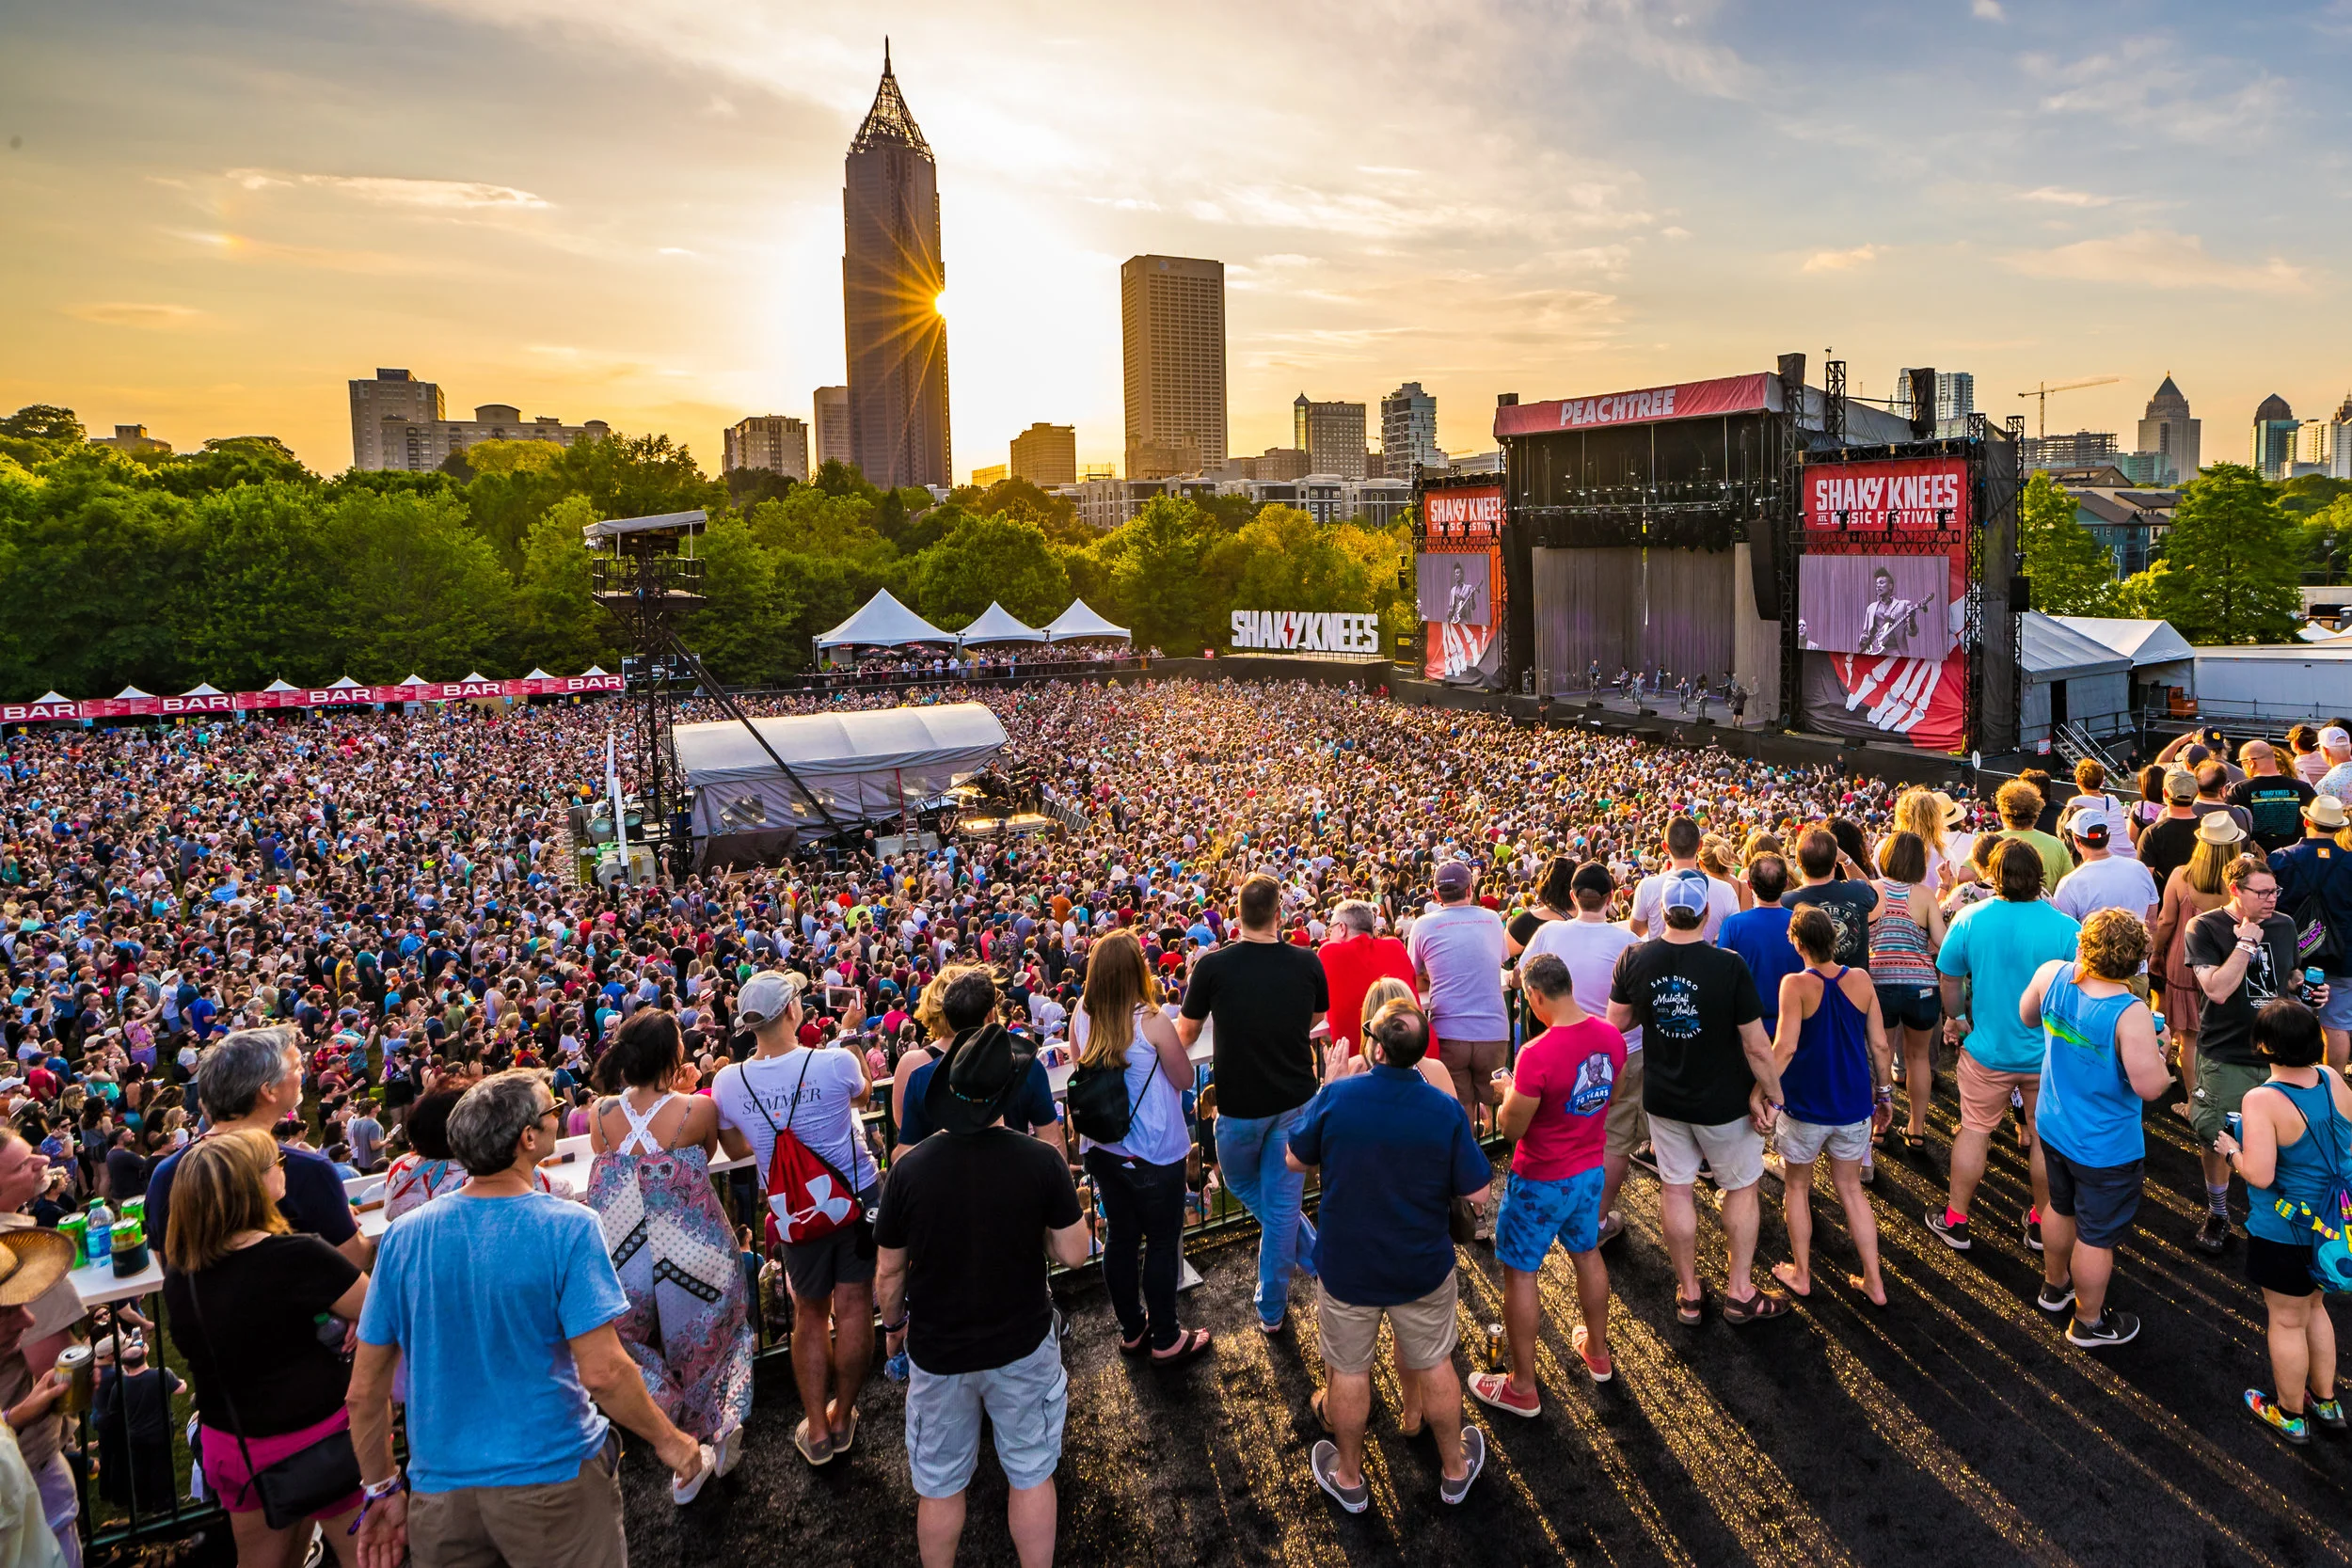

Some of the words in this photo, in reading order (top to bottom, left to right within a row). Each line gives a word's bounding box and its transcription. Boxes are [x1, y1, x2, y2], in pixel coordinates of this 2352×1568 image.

[1561, 388, 1676, 426] PEACHTREE
[1817, 477, 1885, 511] SHAKY
[1887, 474, 1958, 509] KNEES
[1431, 499, 1467, 522] SHAKY
[1831, 512, 1872, 524] MSIC
[443, 683, 500, 696] BAR
[568, 676, 621, 689] BAR
[163, 696, 230, 711] BAR
[310, 689, 371, 703] BAR
[4, 705, 75, 720] BAR
[1650, 976, 1668, 989] SAN
[1673, 974, 1699, 990] DIEGO
[742, 1088, 821, 1115] SUMMER
[1586, 1089, 1609, 1101] YEARS
